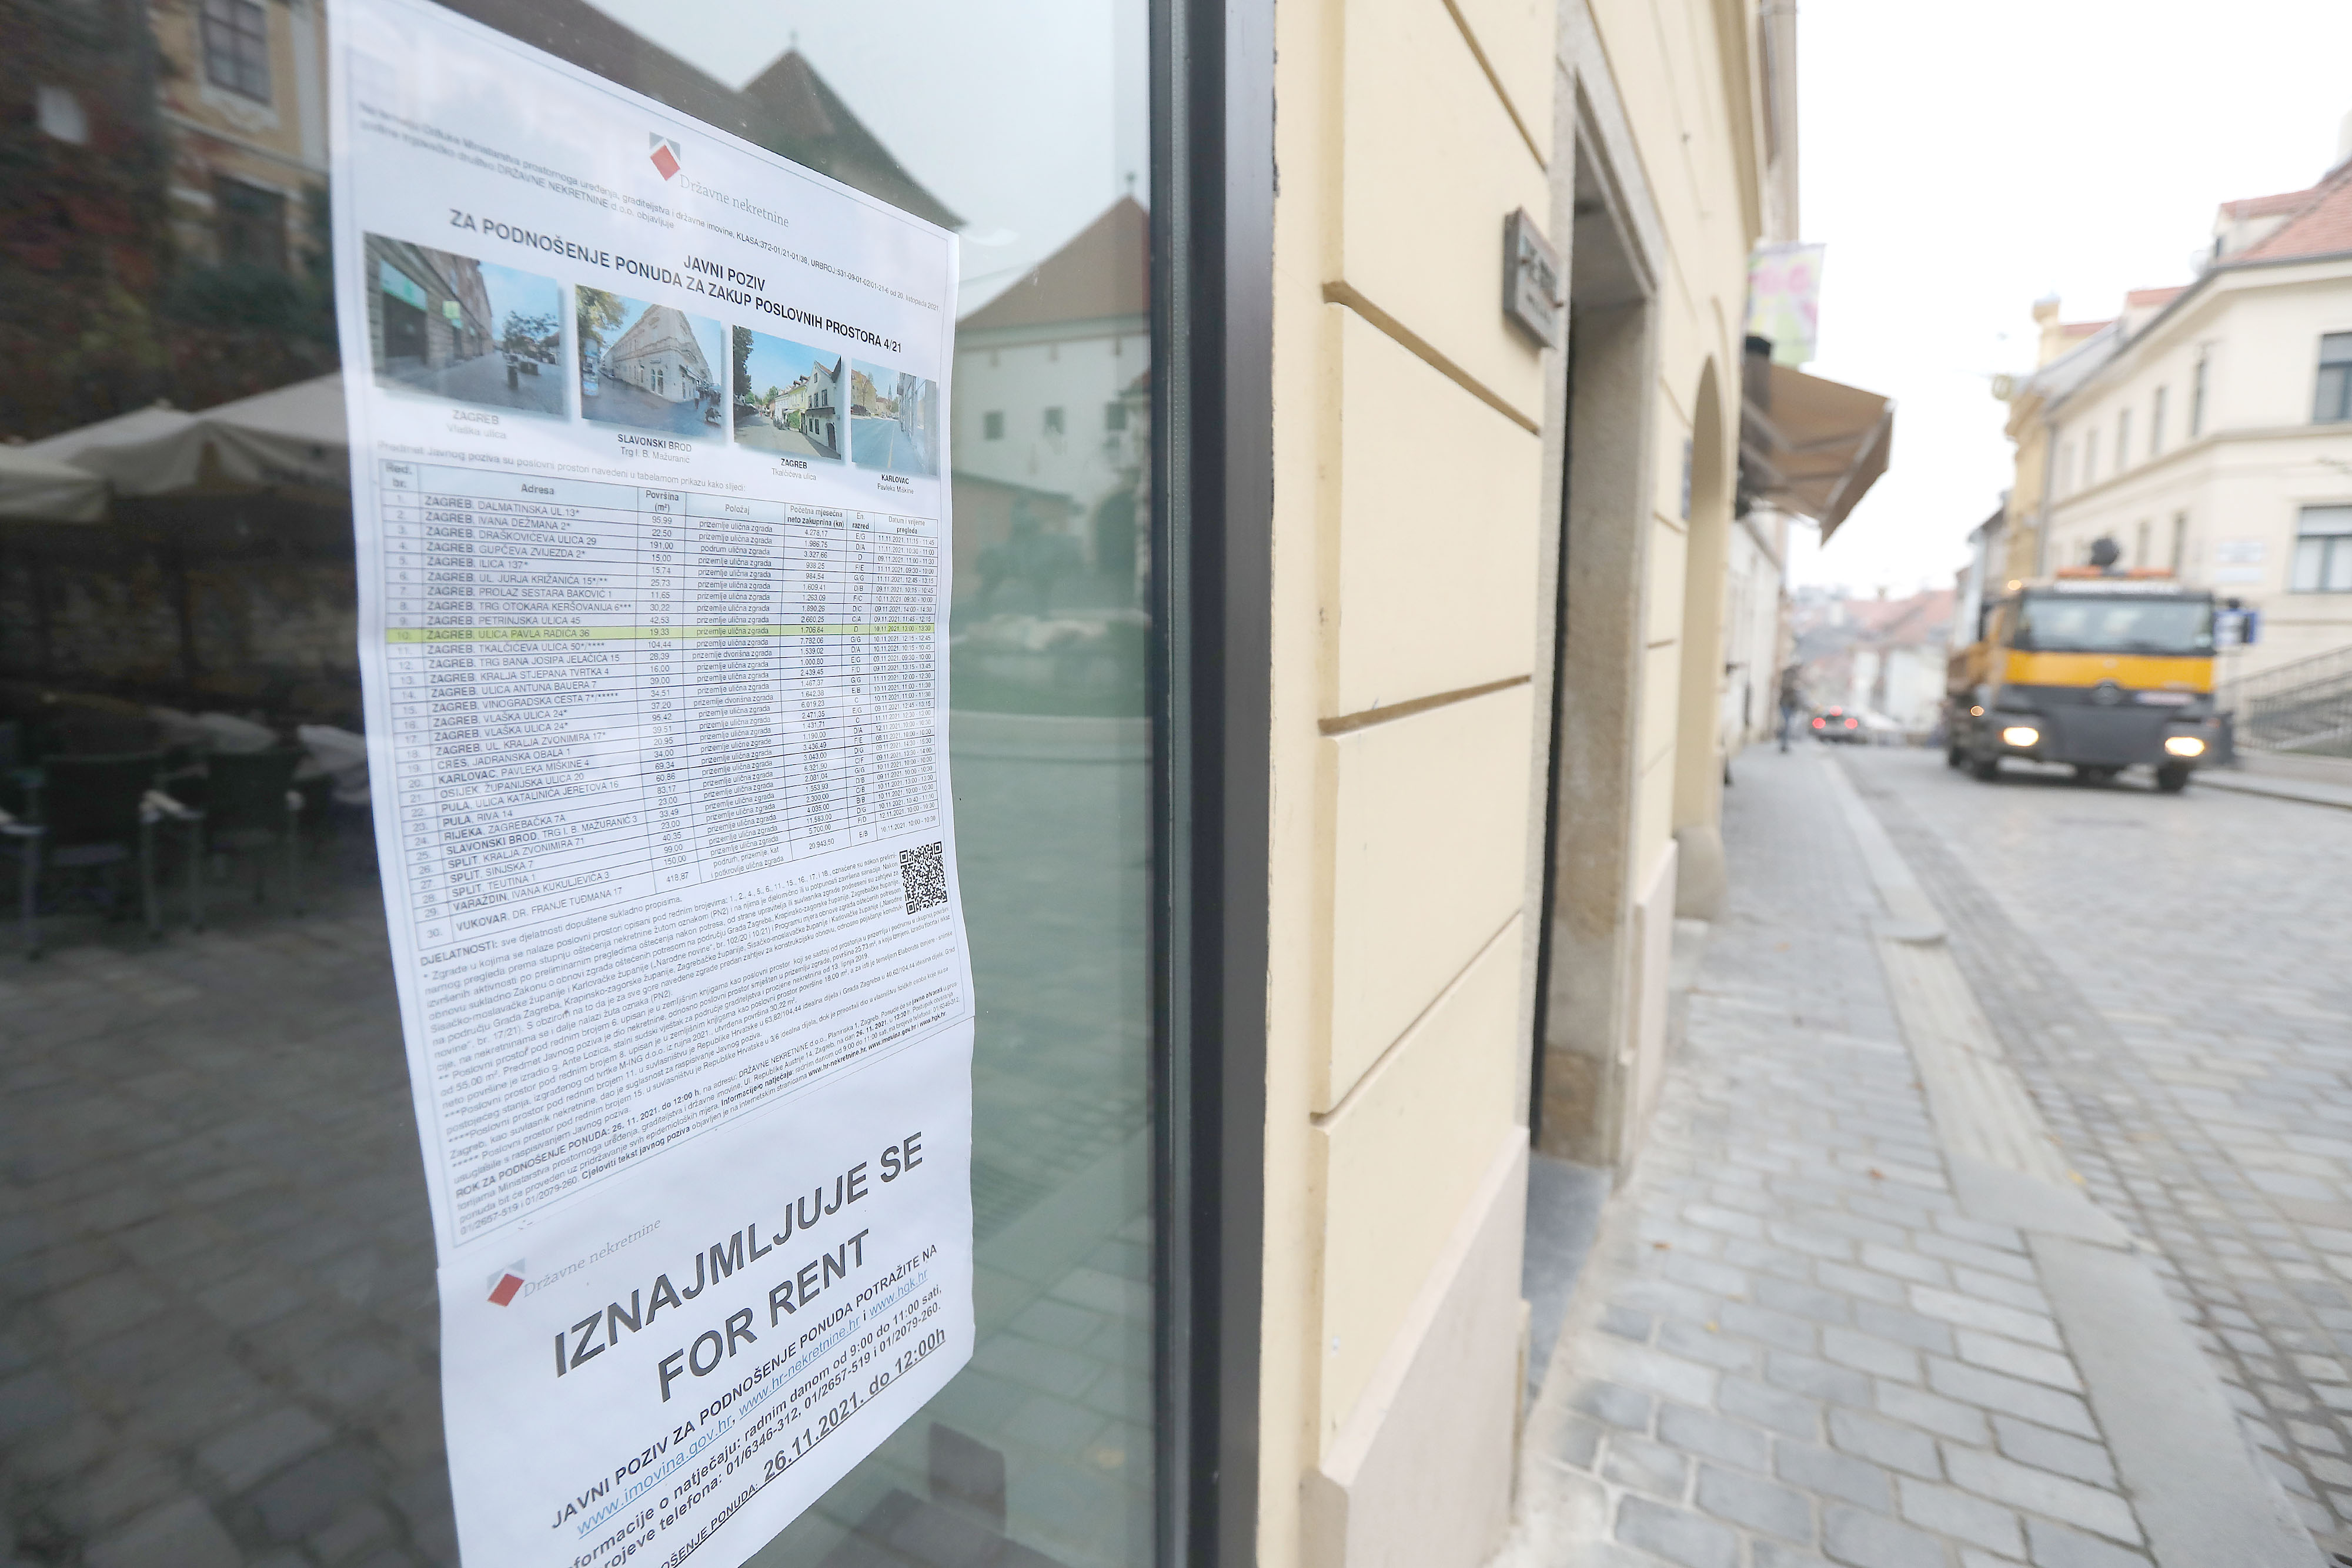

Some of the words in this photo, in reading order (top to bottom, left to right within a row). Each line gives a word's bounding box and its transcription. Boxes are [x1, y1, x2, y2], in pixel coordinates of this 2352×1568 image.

[548, 182, 608, 208] NEKRETNINE
[637, 209, 674, 229] objavljuje
[680, 173, 729, 204] Državne
[733, 197, 789, 228] nekretnine
[676, 210, 705, 228] državne
[449, 208, 475, 231] ZA
[483, 218, 609, 268] PODNOŠENJE
[615, 255, 682, 288] PONUDA
[686, 275, 704, 293] ZA
[709, 282, 751, 307] ZAKUP
[756, 294, 823, 329] POSLOVNIH
[826, 319, 881, 348] PROSTORA
[884, 338, 901, 353] 4/21
[684, 255, 723, 279] JAVNI
[727, 269, 765, 291] POZIV
[618, 434, 666, 449] SLAVONSKI
[669, 442, 691, 452] BROD
[621, 446, 633, 457] Trg
[469, 452, 500, 464] poziva
[503, 457, 513, 465] su
[517, 457, 554, 471] poslovni
[592, 466, 627, 479] navedeni
[681, 477, 705, 487] prikazu
[707, 480, 723, 489] kako
[726, 483, 745, 492] slijedi:
[781, 459, 807, 469] ZAGREB
[521, 483, 554, 495] Adresa
[877, 483, 895, 492] Pavleka
[897, 486, 914, 494] Miškine
[882, 474, 909, 484] KARLOVAC
[478, 500, 547, 514] DALMATINSKA
[646, 490, 679, 500] Površina
[725, 504, 750, 515] Položaj
[790, 506, 813, 515] Početna
[816, 509, 842, 519] mjesečna
[888, 516, 904, 524] Datum
[908, 519, 925, 527] vrijeme
[802, 517, 831, 528] zakupnina
[479, 630, 507, 638] ULICA
[510, 630, 540, 638] PAVLA
[696, 627, 727, 636] prizemlje
[729, 627, 744, 635] ulična
[446, 837, 506, 855] SLAVONSKI
[542, 828, 560, 838] TRG
[512, 886, 540, 898] IVANA
[542, 872, 603, 893] KUKULJEVIĆA
[532, 900, 567, 915] FRANJE
[570, 890, 612, 907] TUĐMANA
[420, 940, 497, 967] DJELATNOSTI:
[920, 1011, 946, 1029] www.hgk.hr
[456, 1181, 480, 1199] ROK
[482, 1176, 496, 1189] ZA
[499, 1146, 566, 1181] PODNOŠENJE
[569, 1128, 610, 1152] PONUDA:
[662, 1100, 671, 1111] do
[673, 1092, 692, 1107] 12:00
[524, 1260, 586, 1297] Državne
[589, 1218, 662, 1264] nekretnine
[555, 1162, 869, 1378] IZNAJMLJUJE
[880, 1131, 924, 1184] SE
[657, 1308, 758, 1403] FOR
[770, 1229, 870, 1329] RENT
[739, 1314, 861, 1419] www.hr-nekretnine.hr
[870, 1268, 928, 1319] www.hgk.hr
[552, 1479, 610, 1529] JAVNI
[615, 1436, 669, 1485] POZIV
[673, 1419, 696, 1446] ZA
[700, 1342, 796, 1427] PODNOŠENJE
[800, 1303, 853, 1350] PONUDA
[856, 1258, 920, 1312] POTRAŽITE
[922, 1244, 937, 1266] NA
[659, 1495, 669, 1512] o
[673, 1442, 741, 1503] natječaju:
[744, 1400, 787, 1444] radnim
[790, 1370, 830, 1408] danom
[833, 1358, 847, 1377] od
[850, 1335, 873, 1358] 9:00
[876, 1320, 890, 1340] do
[893, 1299, 920, 1330] 11:00
[923, 1285, 942, 1310] sati,
[660, 1475, 723, 1533] telefona:
[727, 1409, 801, 1477] 01/6346-312,
[805, 1351, 870, 1412] 01/2657-519
[880, 1303, 941, 1353] 01/2079-260.
[710, 1482, 759, 1532] PONUDA:
[763, 1392, 864, 1482] 26.11.2021.
[868, 1370, 891, 1396] do
[895, 1328, 946, 1372] 12:00h
